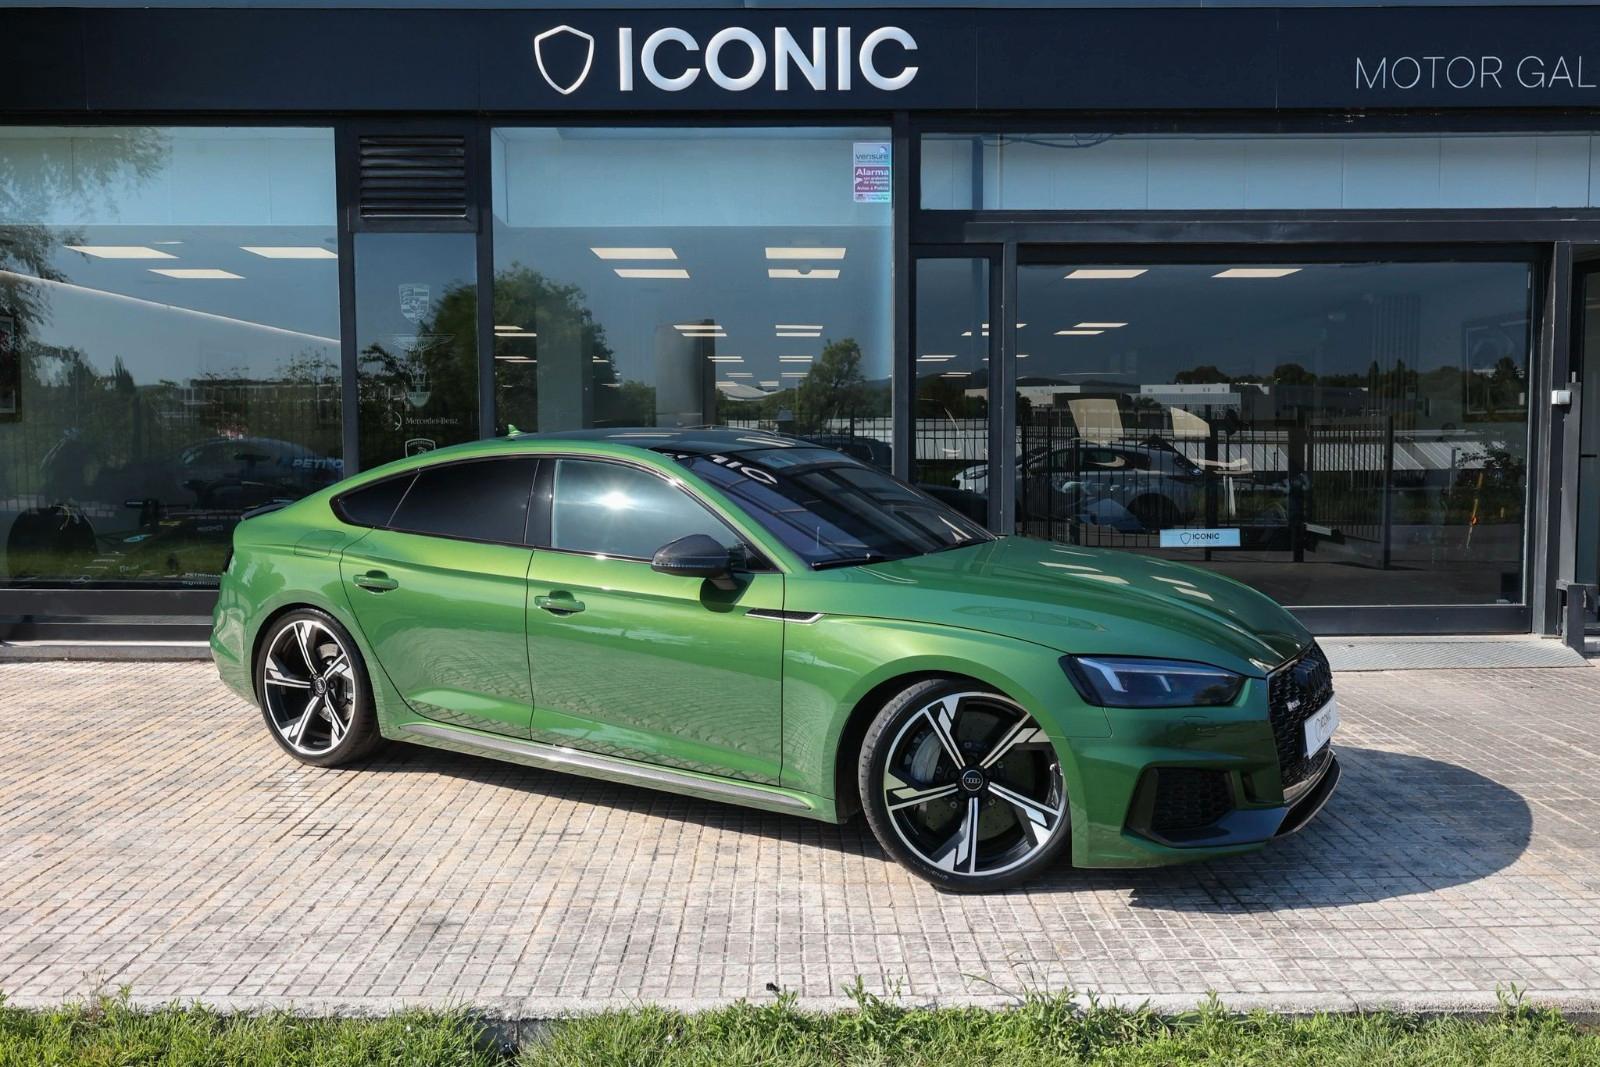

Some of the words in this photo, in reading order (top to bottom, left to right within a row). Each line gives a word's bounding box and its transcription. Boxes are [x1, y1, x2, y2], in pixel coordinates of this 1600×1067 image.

[618, 26, 919, 92] ICONIC
[1355, 56, 1503, 89] MOTOR
[1516, 55, 1598, 89] GAL
[856, 168, 889, 176] Alarma
[405, 416, 460, 425] Mercedes-Benz
[1192, 532, 1220, 540] ICONIC
